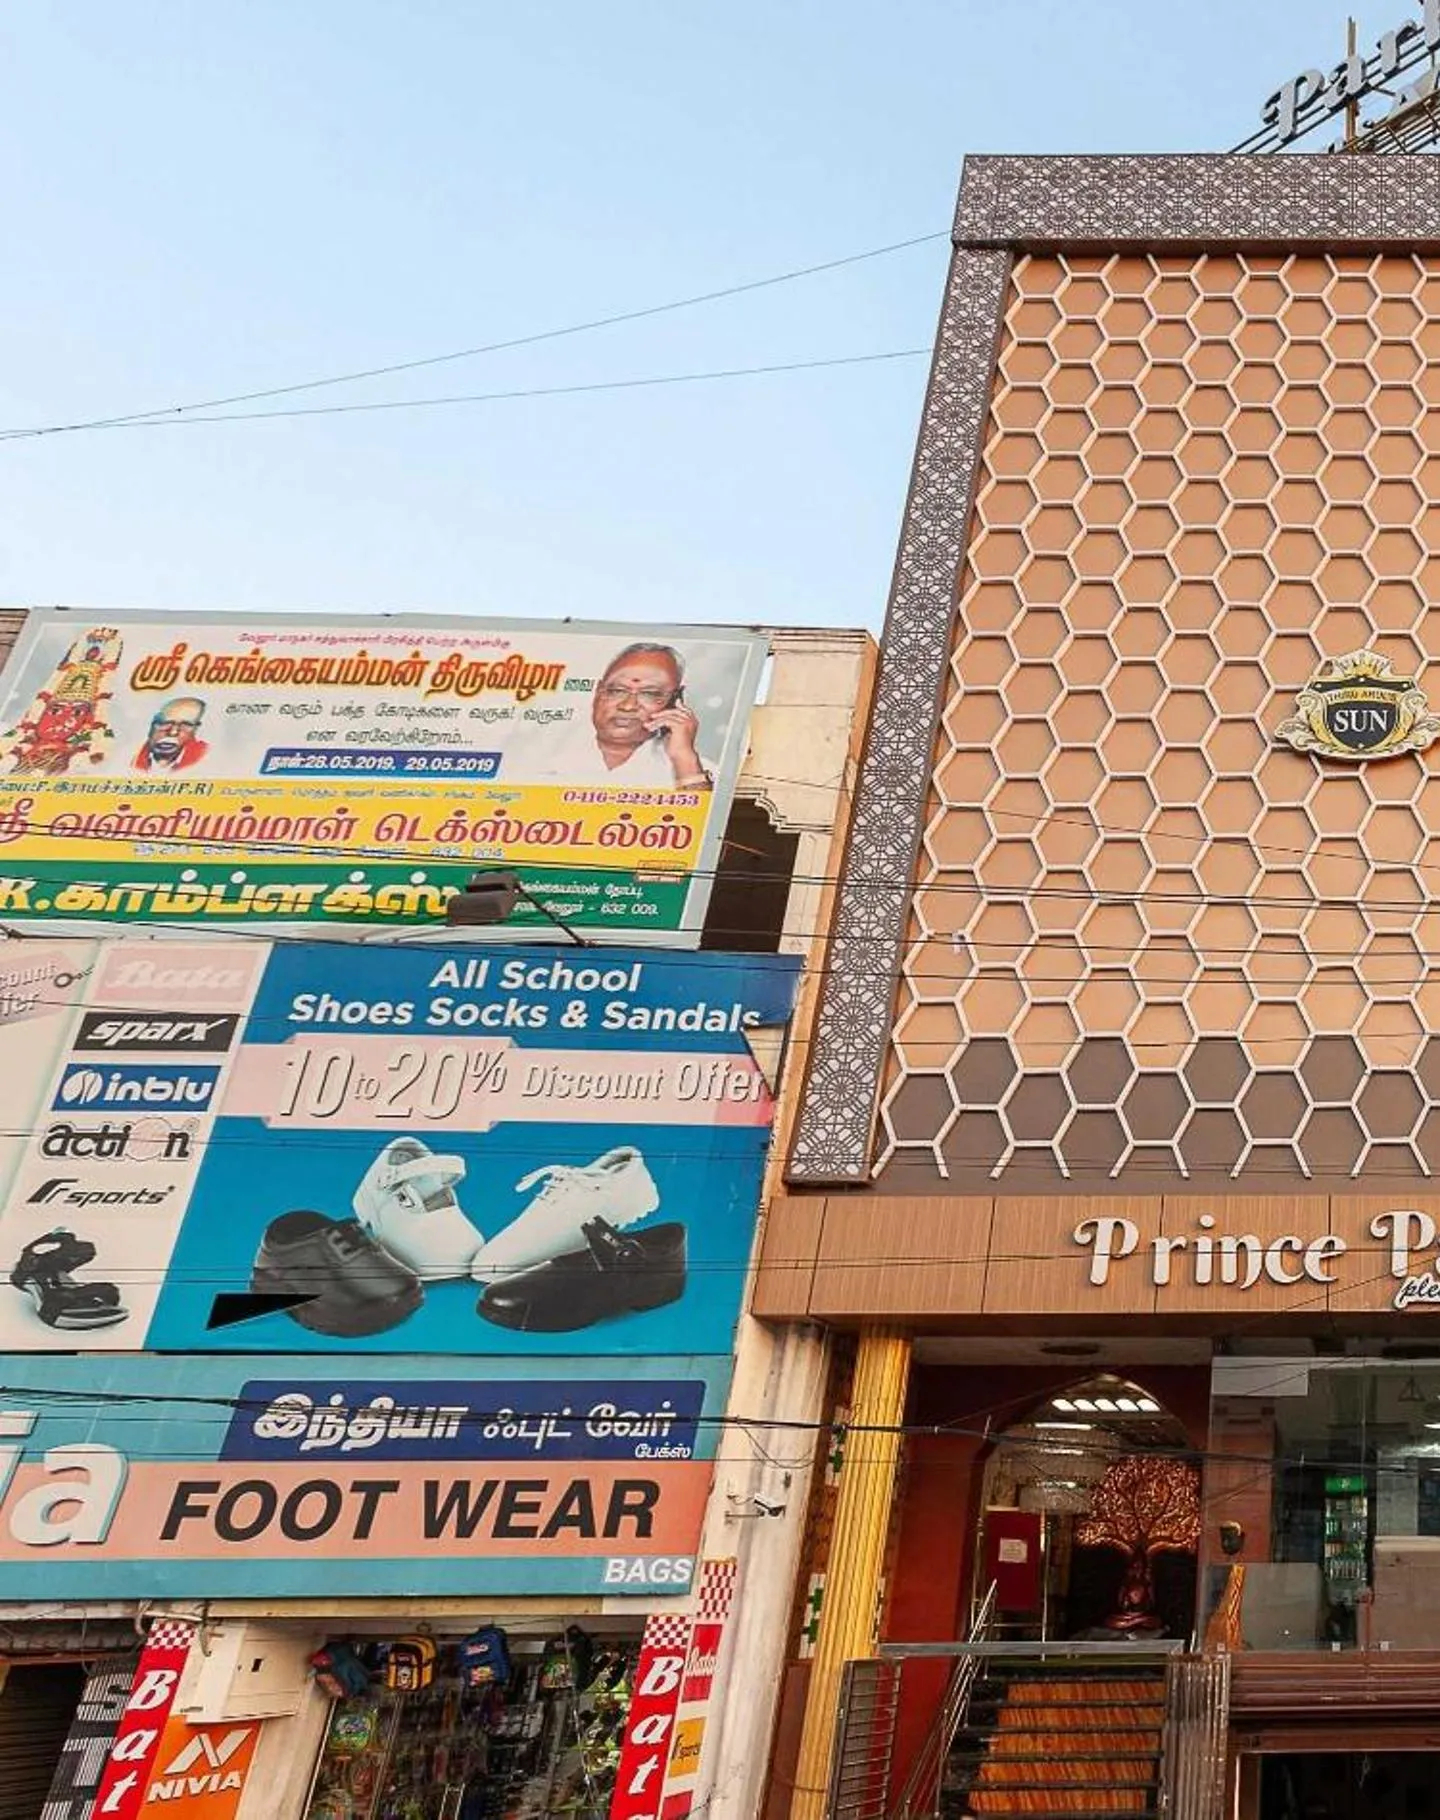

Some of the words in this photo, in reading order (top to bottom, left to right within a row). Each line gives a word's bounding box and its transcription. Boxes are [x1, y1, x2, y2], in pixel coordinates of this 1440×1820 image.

[130, 642, 188, 691] ஸ்ரீ
[185, 648, 428, 687] கெங்கையம்மன்
[424, 653, 566, 701] திருவிழா
[1333, 709, 1389, 732] SUN
[404, 756, 494, 772] 29.05.2019
[50, 804, 359, 843] வள்ளியம்மாள்
[374, 809, 692, 850] டெக்ஸ்டைல்ஸ்
[428, 959, 490, 989] All
[499, 960, 643, 992] School
[288, 994, 415, 1025] Shoes
[426, 997, 549, 1028] Socks
[559, 1000, 589, 1028] &
[601, 1001, 762, 1032] Sandals
[86, 1018, 228, 1047] sparx
[104, 1073, 212, 1102] inblu
[521, 1063, 664, 1099] Discount
[674, 1059, 766, 1103] Offer
[1072, 1214, 1347, 1290] Prince
[253, 1393, 469, 1451] இந்தியா
[483, 1407, 572, 1449] ஃபுட்
[586, 1401, 676, 1437] வேர்
[634, 1442, 692, 1459] பேக்ஸ்
[160, 1479, 400, 1541] FOOT
[422, 1479, 660, 1540] WEAR
[604, 1558, 693, 1584] BAGS
[627, 1656, 685, 1820] Bat
[148, 1772, 242, 1801] NIVIA
